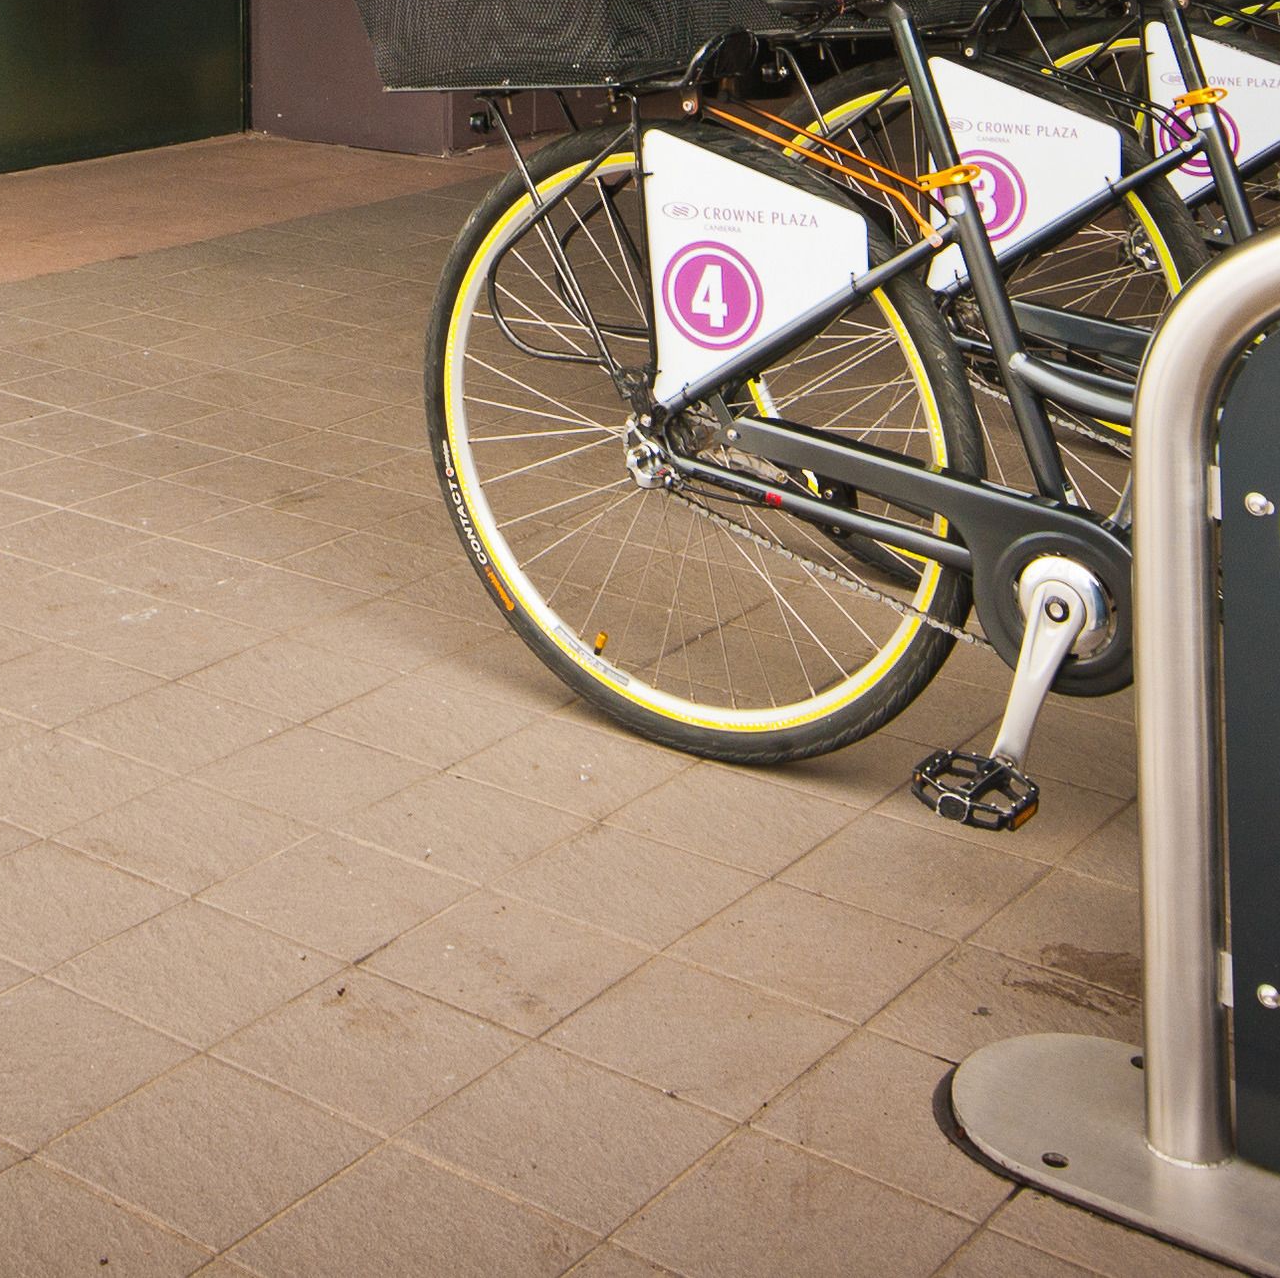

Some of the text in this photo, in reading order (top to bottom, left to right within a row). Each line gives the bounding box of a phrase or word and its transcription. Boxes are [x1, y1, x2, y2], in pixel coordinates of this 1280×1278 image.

[976, 121, 1079, 139] CROWNE PLAZA
[703, 206, 819, 228] CROWNE PLAZA
[691, 264, 728, 329] 4
[447, 478, 488, 566] CONTACT
